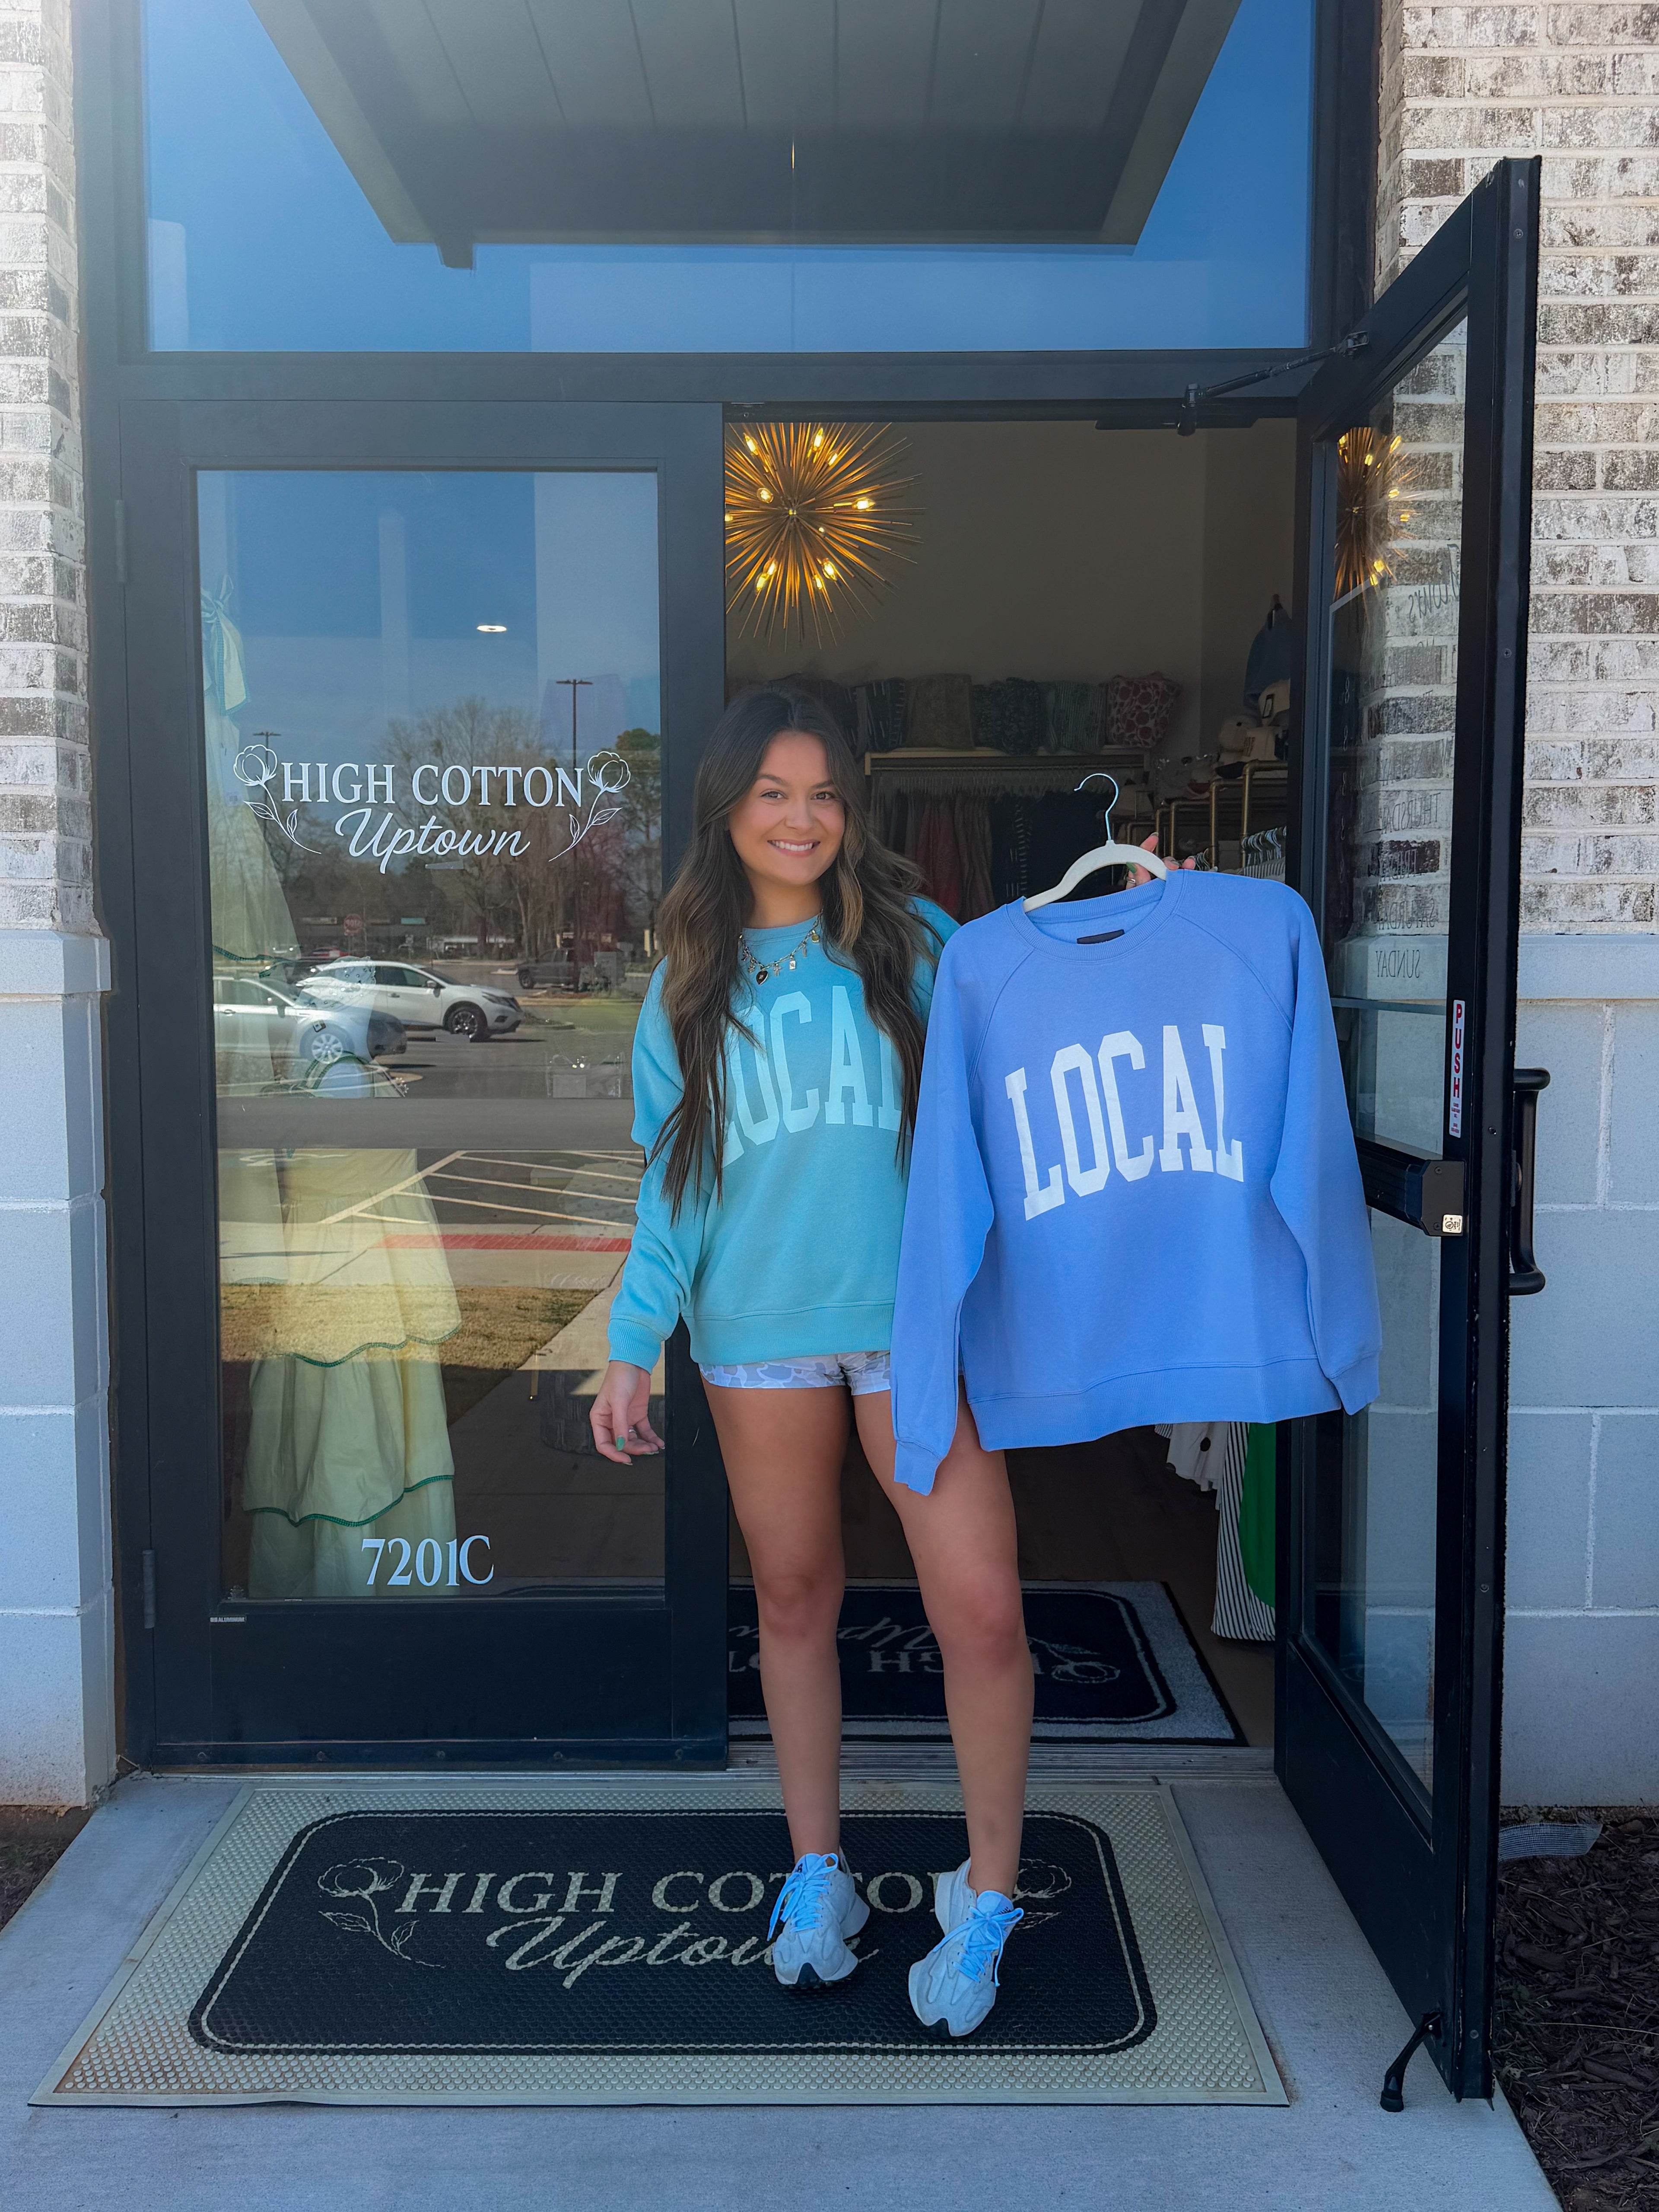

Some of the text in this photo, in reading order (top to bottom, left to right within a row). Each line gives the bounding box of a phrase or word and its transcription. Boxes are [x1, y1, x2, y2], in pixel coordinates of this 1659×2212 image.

[281, 762, 584, 807] HIGH COTTON
[335, 808, 530, 874] Uptown
[1453, 1003, 1462, 1098] PUSH
[1005, 1023, 1244, 1221] LOCAL
[362, 1535, 494, 1586] 7201C
[394, 1871, 940, 1913] HIGH COO
[486, 1916, 880, 1989] Upto
